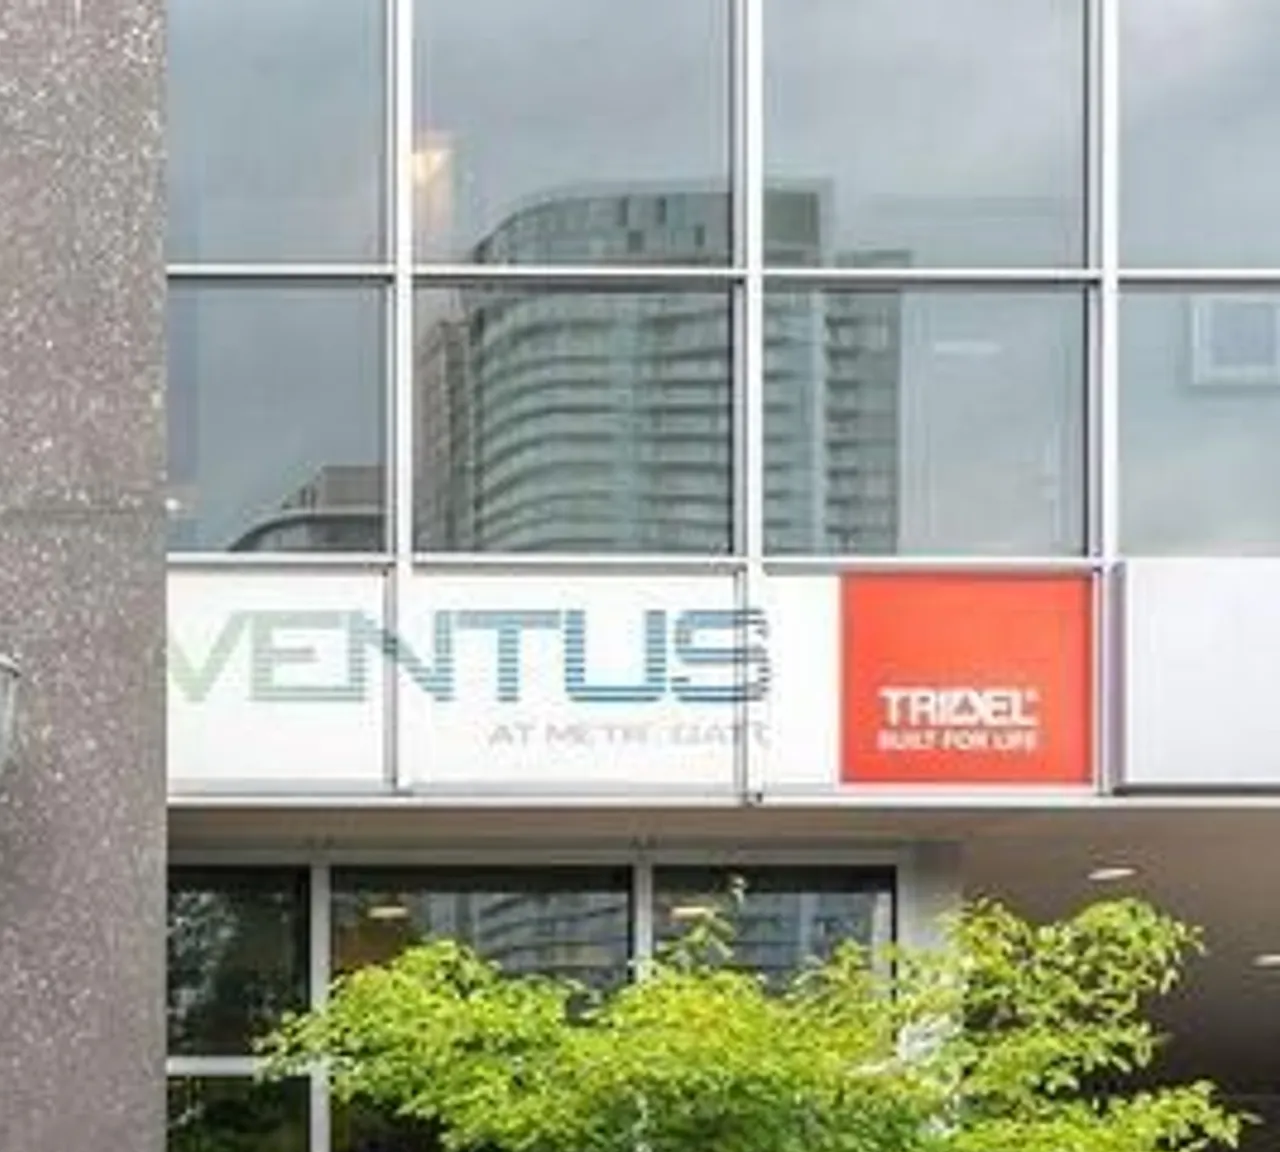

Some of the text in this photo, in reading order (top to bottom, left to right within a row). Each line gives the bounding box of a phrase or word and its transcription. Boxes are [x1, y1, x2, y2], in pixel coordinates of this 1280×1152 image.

[167, 609, 771, 703] VENTUS
[877, 729, 941, 750] BUILT
[943, 729, 989, 751] FOR
